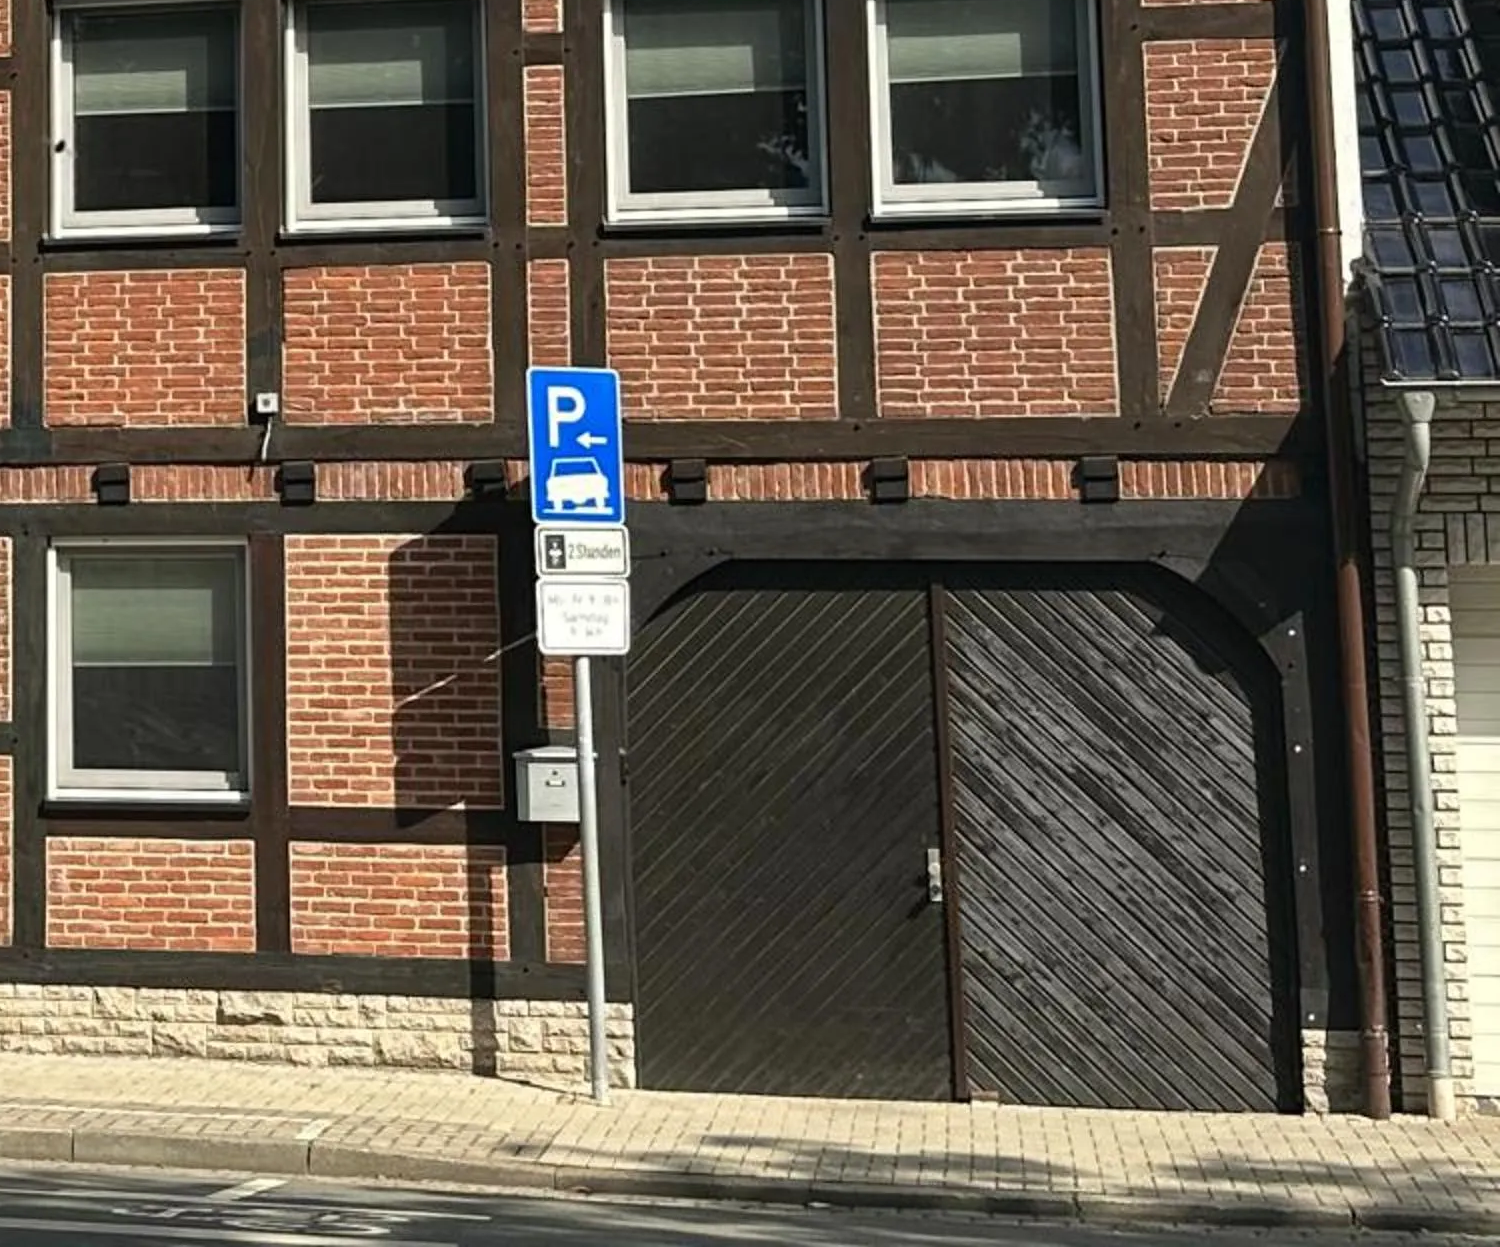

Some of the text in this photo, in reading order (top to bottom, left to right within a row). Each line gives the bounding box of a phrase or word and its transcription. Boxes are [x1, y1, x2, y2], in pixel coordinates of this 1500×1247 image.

[547, 385, 586, 448] P
[568, 543, 621, 559] 2 Stunden
